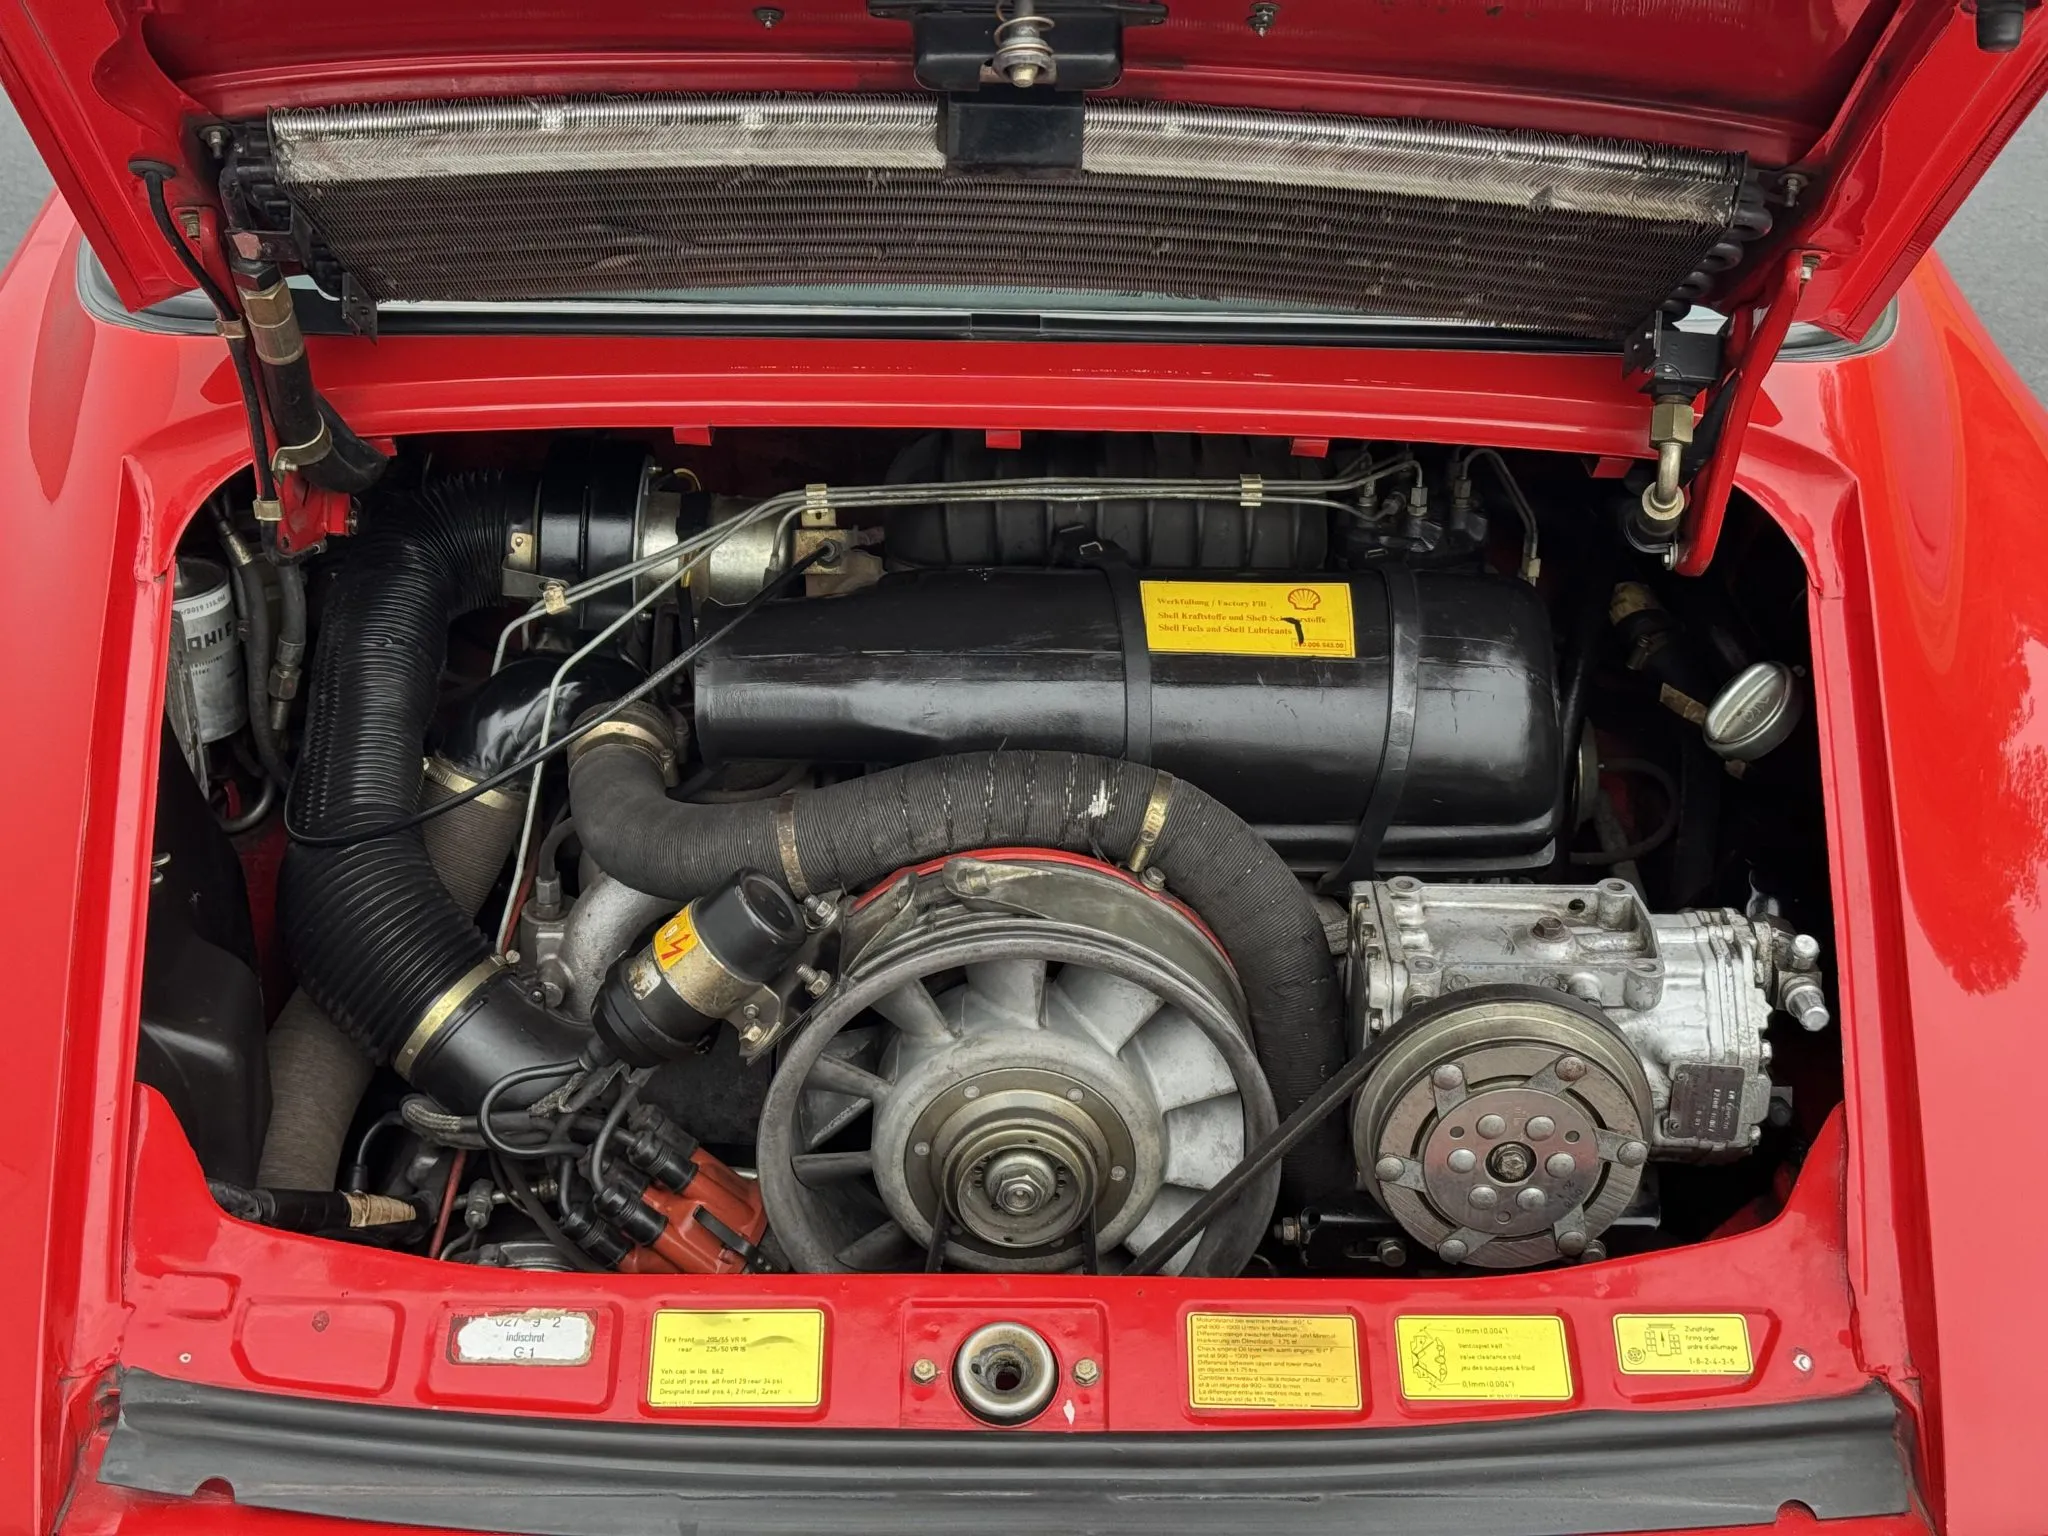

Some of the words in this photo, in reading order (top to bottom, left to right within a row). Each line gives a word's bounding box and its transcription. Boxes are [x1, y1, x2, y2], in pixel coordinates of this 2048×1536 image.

[1218, 600, 1249, 608] Factory
[1182, 612, 1226, 621] Kraftstoffe
[1158, 624, 1179, 632] Shell
[1248, 626, 1292, 635] Lubricants
[506, 1332, 545, 1342] indischrot
